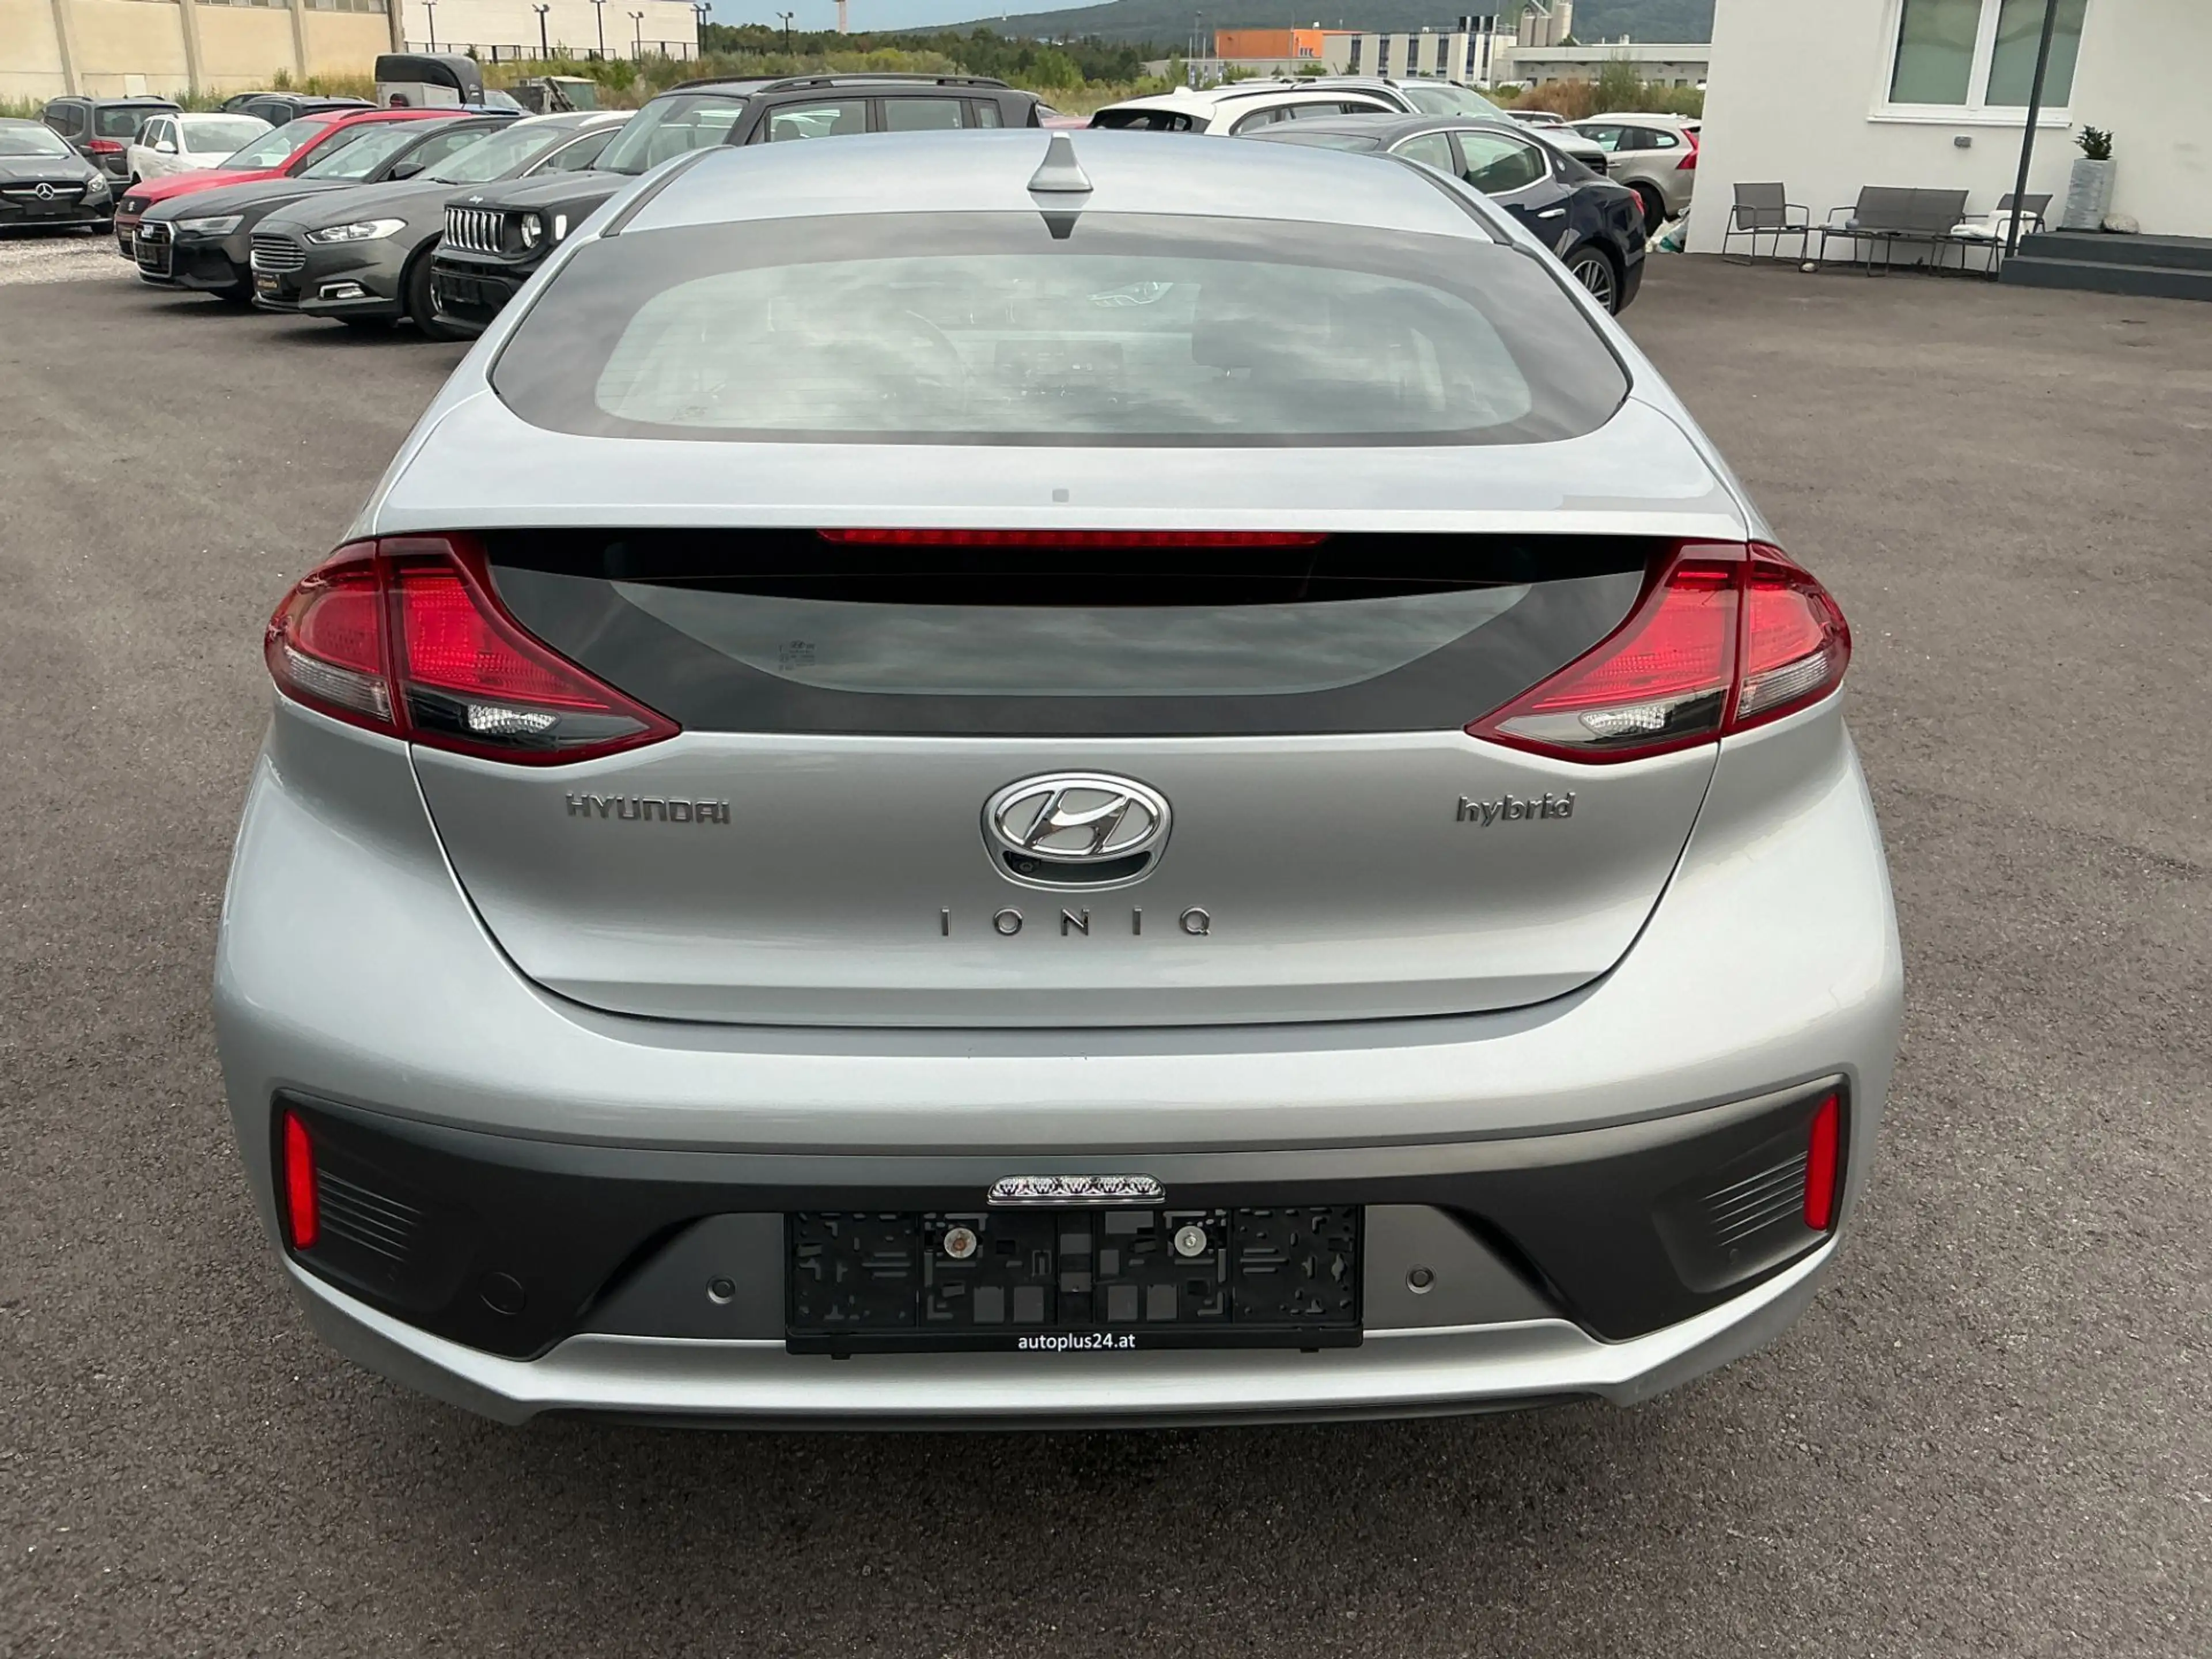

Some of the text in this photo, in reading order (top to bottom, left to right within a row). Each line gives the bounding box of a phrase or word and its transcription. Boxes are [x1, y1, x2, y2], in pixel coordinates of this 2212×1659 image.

[566, 791, 731, 824] HYUNDAI
[1457, 791, 1576, 827] hybrid
[940, 905, 1211, 937] IONIQ
[1018, 1332, 1136, 1352] autoplus24.at
